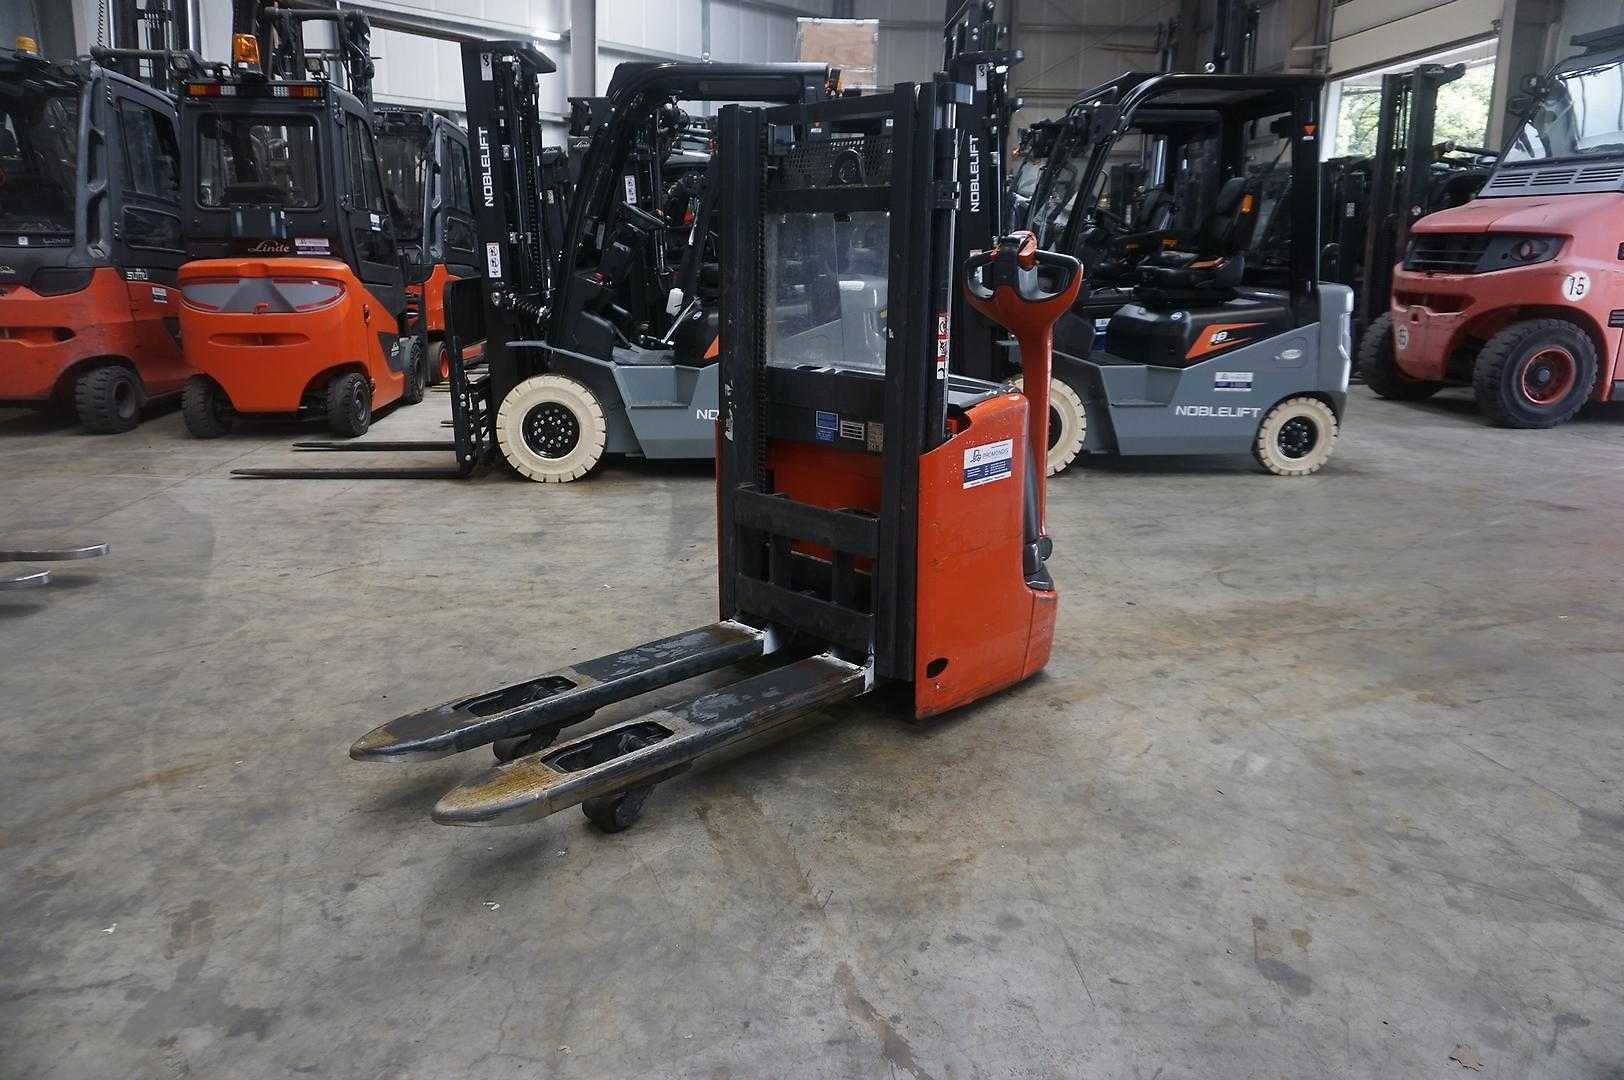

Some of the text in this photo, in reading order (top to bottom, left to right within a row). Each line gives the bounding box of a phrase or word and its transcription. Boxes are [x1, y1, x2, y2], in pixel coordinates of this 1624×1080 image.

[478, 126, 494, 207] NOBLELIFT
[969, 134, 980, 212] NOBLELIFT
[247, 240, 290, 252] Linde
[1175, 405, 1262, 418] NOBLELIFT
